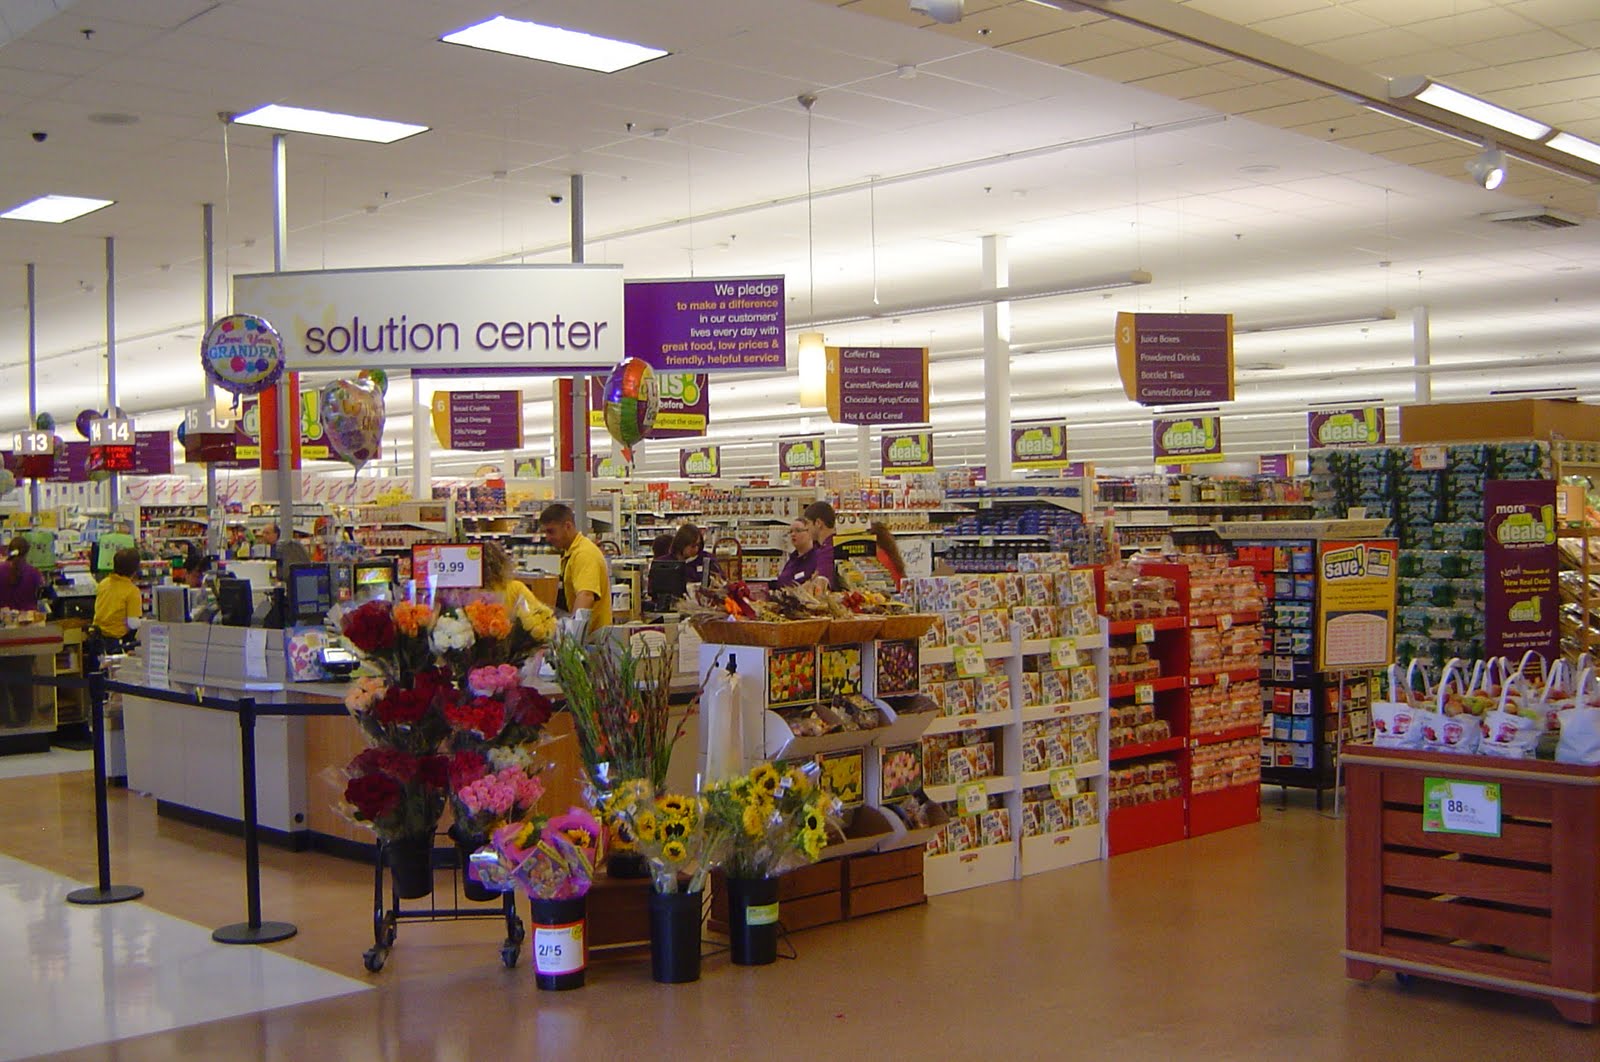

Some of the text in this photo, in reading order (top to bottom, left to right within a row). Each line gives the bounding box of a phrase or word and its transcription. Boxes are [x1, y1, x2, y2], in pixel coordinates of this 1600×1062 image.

[715, 284, 778, 299] We pledge
[677, 302, 687, 311] to
[690, 301, 717, 310] make
[728, 300, 778, 309] difference
[700, 314, 708, 324] in
[711, 315, 725, 323] our
[306, 314, 608, 354] solution center
[691, 326, 779, 339] lives every day with
[1122, 326, 1130, 344] 3
[1140, 335, 1180, 344] Juice Boxes
[208, 345, 278, 360] GRANDPA
[662, 340, 779, 354] great food, low prices &
[666, 353, 779, 367] friendly, helpful service
[1140, 353, 1201, 362] Powdered Drinks
[827, 360, 835, 374] 4
[844, 366, 858, 374] Iced
[860, 366, 871, 374] Tea
[1141, 371, 1185, 379] Bottled Teas
[905, 381, 919, 389] Milk
[1194, 388, 1211, 398] Juice
[660, 401, 684, 409] before
[844, 396, 877, 404] Chocolate
[437, 400, 445, 412] 6
[187, 409, 198, 429] 15
[866, 412, 881, 420] Cold
[883, 412, 903, 420] Cereal
[108, 422, 130, 441] 14
[27, 434, 48, 451] 13
[1496, 505, 1525, 514] more
